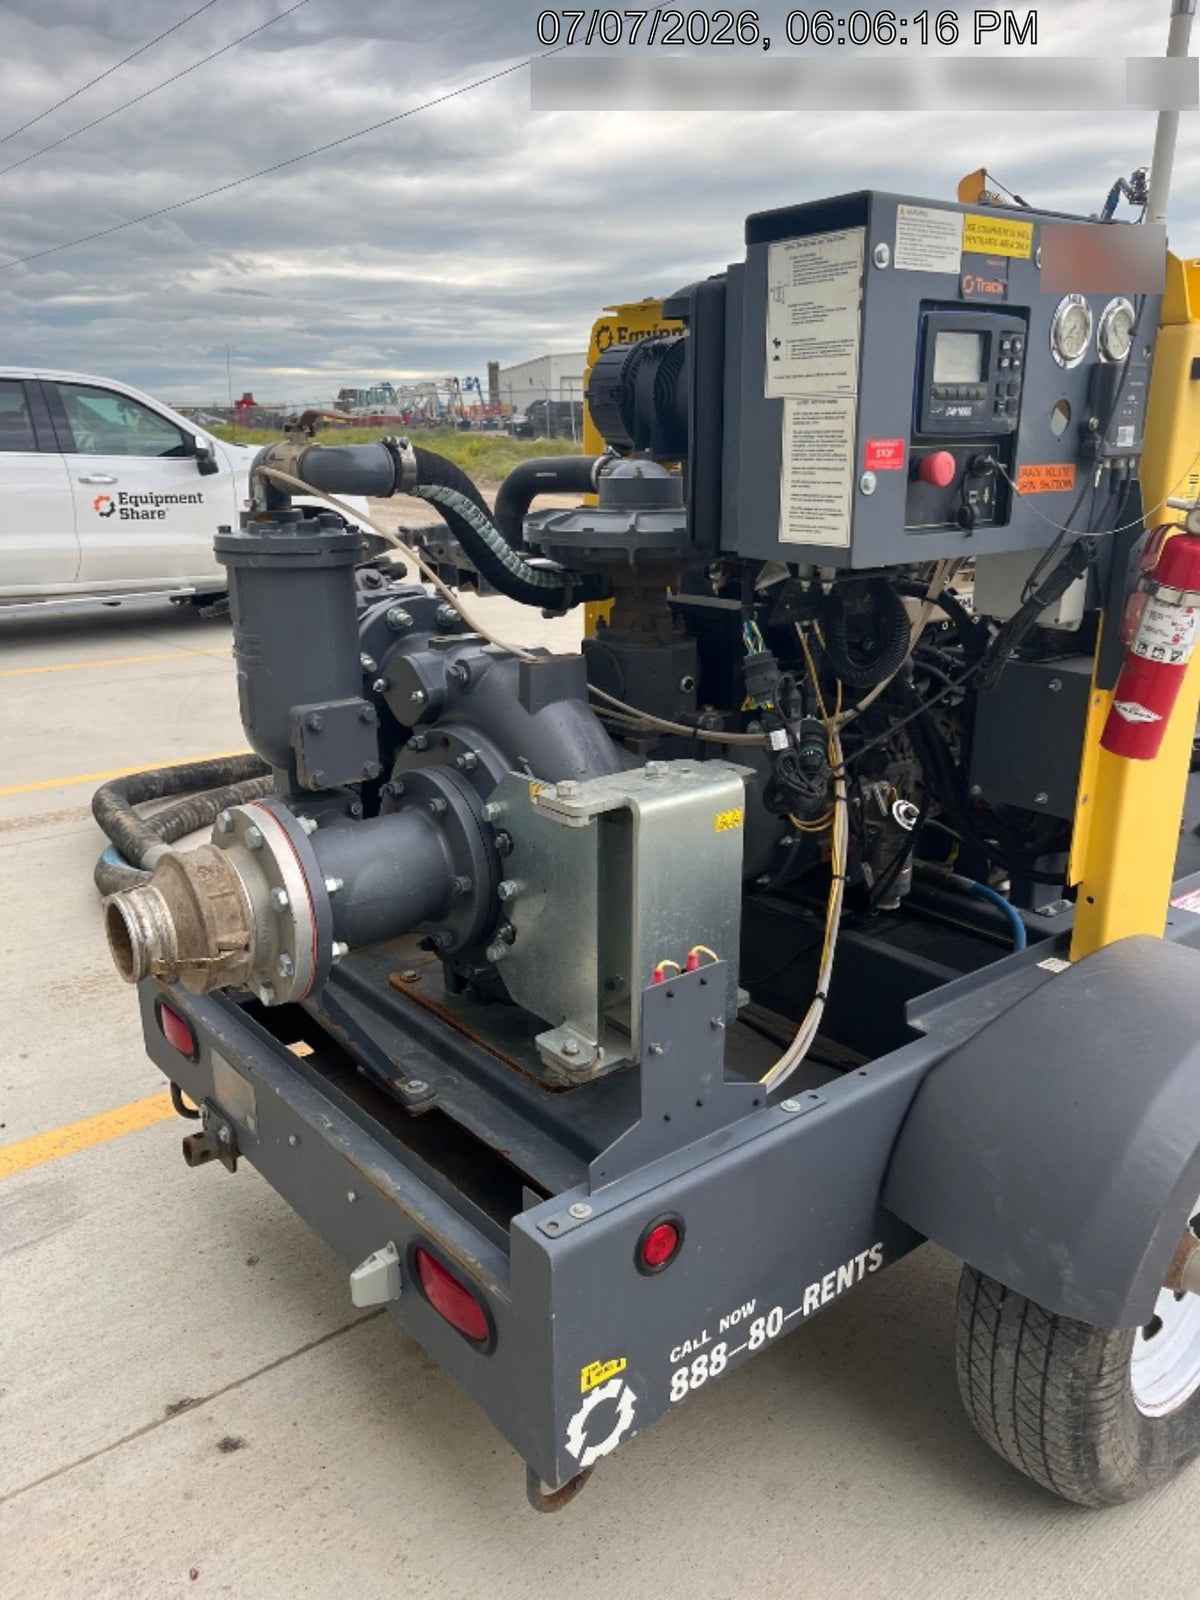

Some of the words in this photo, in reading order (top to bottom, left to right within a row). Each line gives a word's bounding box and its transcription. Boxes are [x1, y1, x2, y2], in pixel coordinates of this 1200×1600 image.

[875, 448, 895, 458] STOP
[117, 492, 204, 507] Equipment
[119, 508, 166, 520] Share
[670, 1329, 712, 1363] CALL
[719, 1298, 756, 1334] NOW
